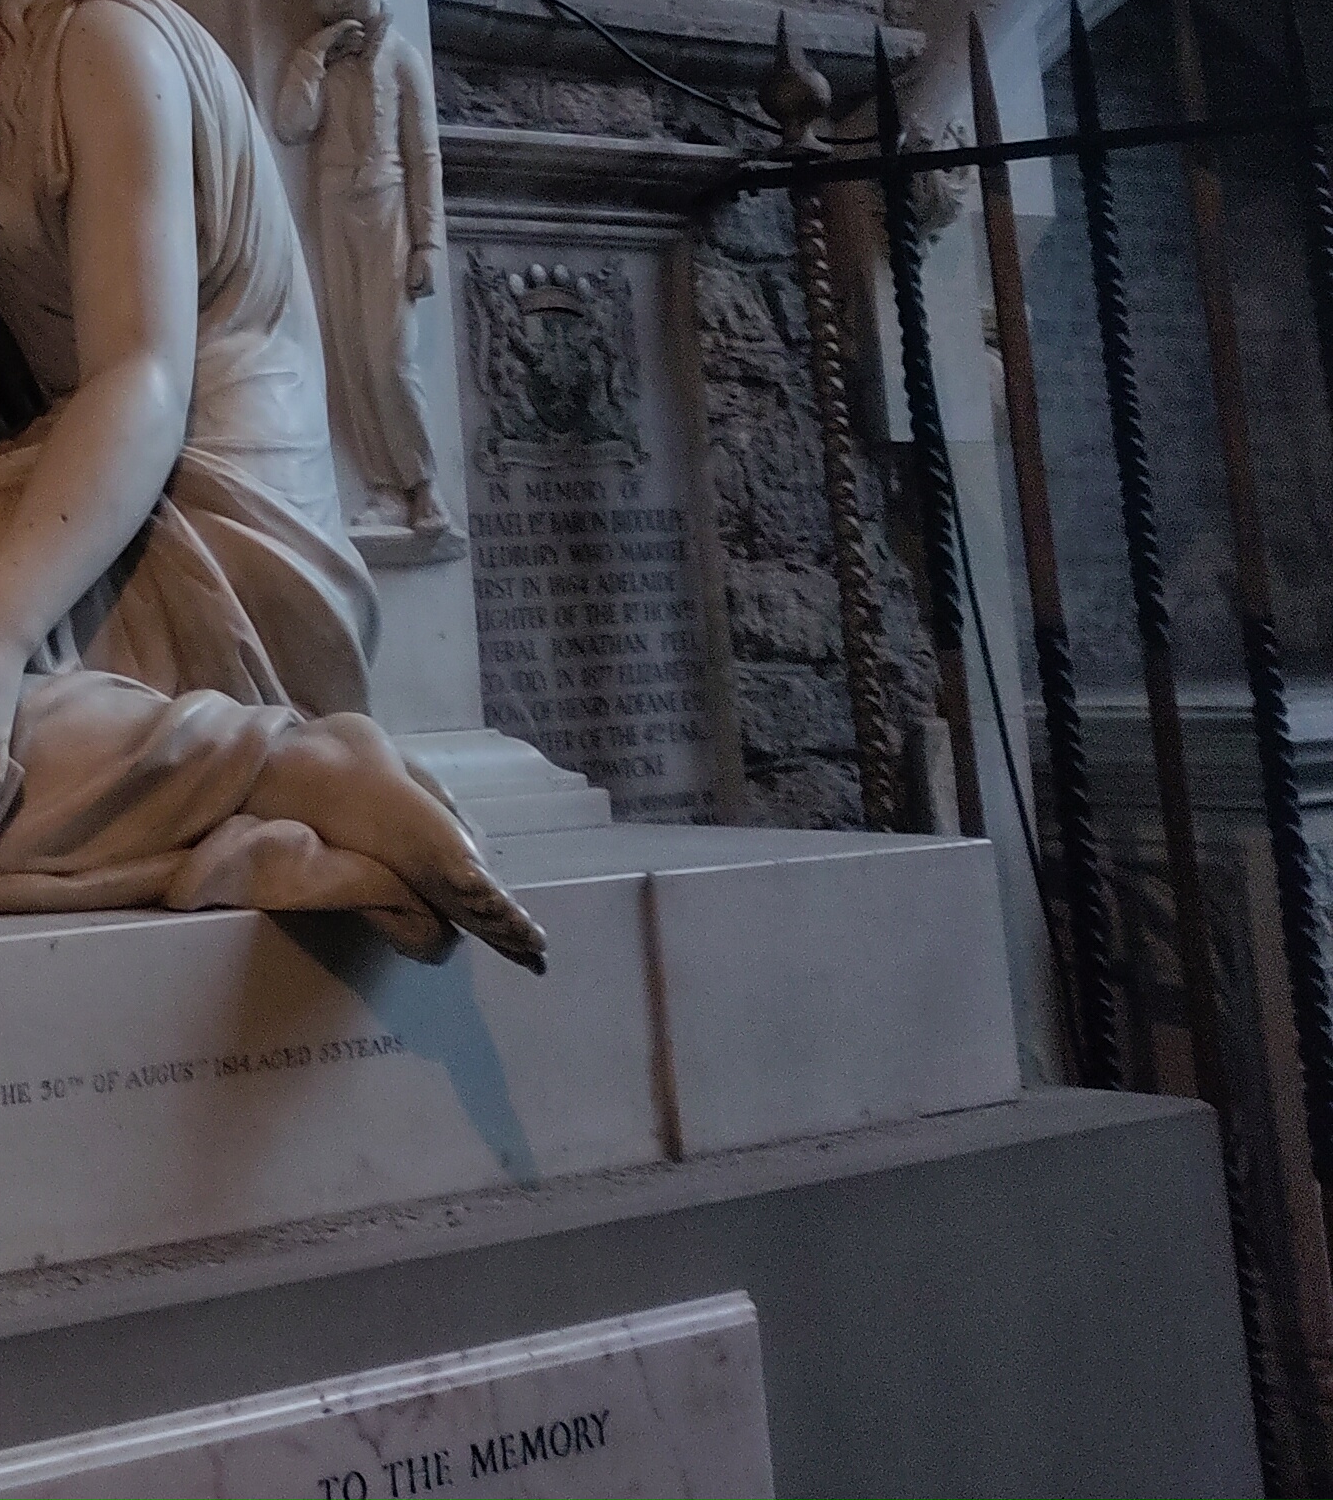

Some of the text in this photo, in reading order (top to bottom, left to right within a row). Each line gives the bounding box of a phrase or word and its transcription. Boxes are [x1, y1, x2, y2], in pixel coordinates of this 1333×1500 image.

[92, 1070, 119, 1094] OF
[318, 1408, 610, 1500] TO THE MEMORY
